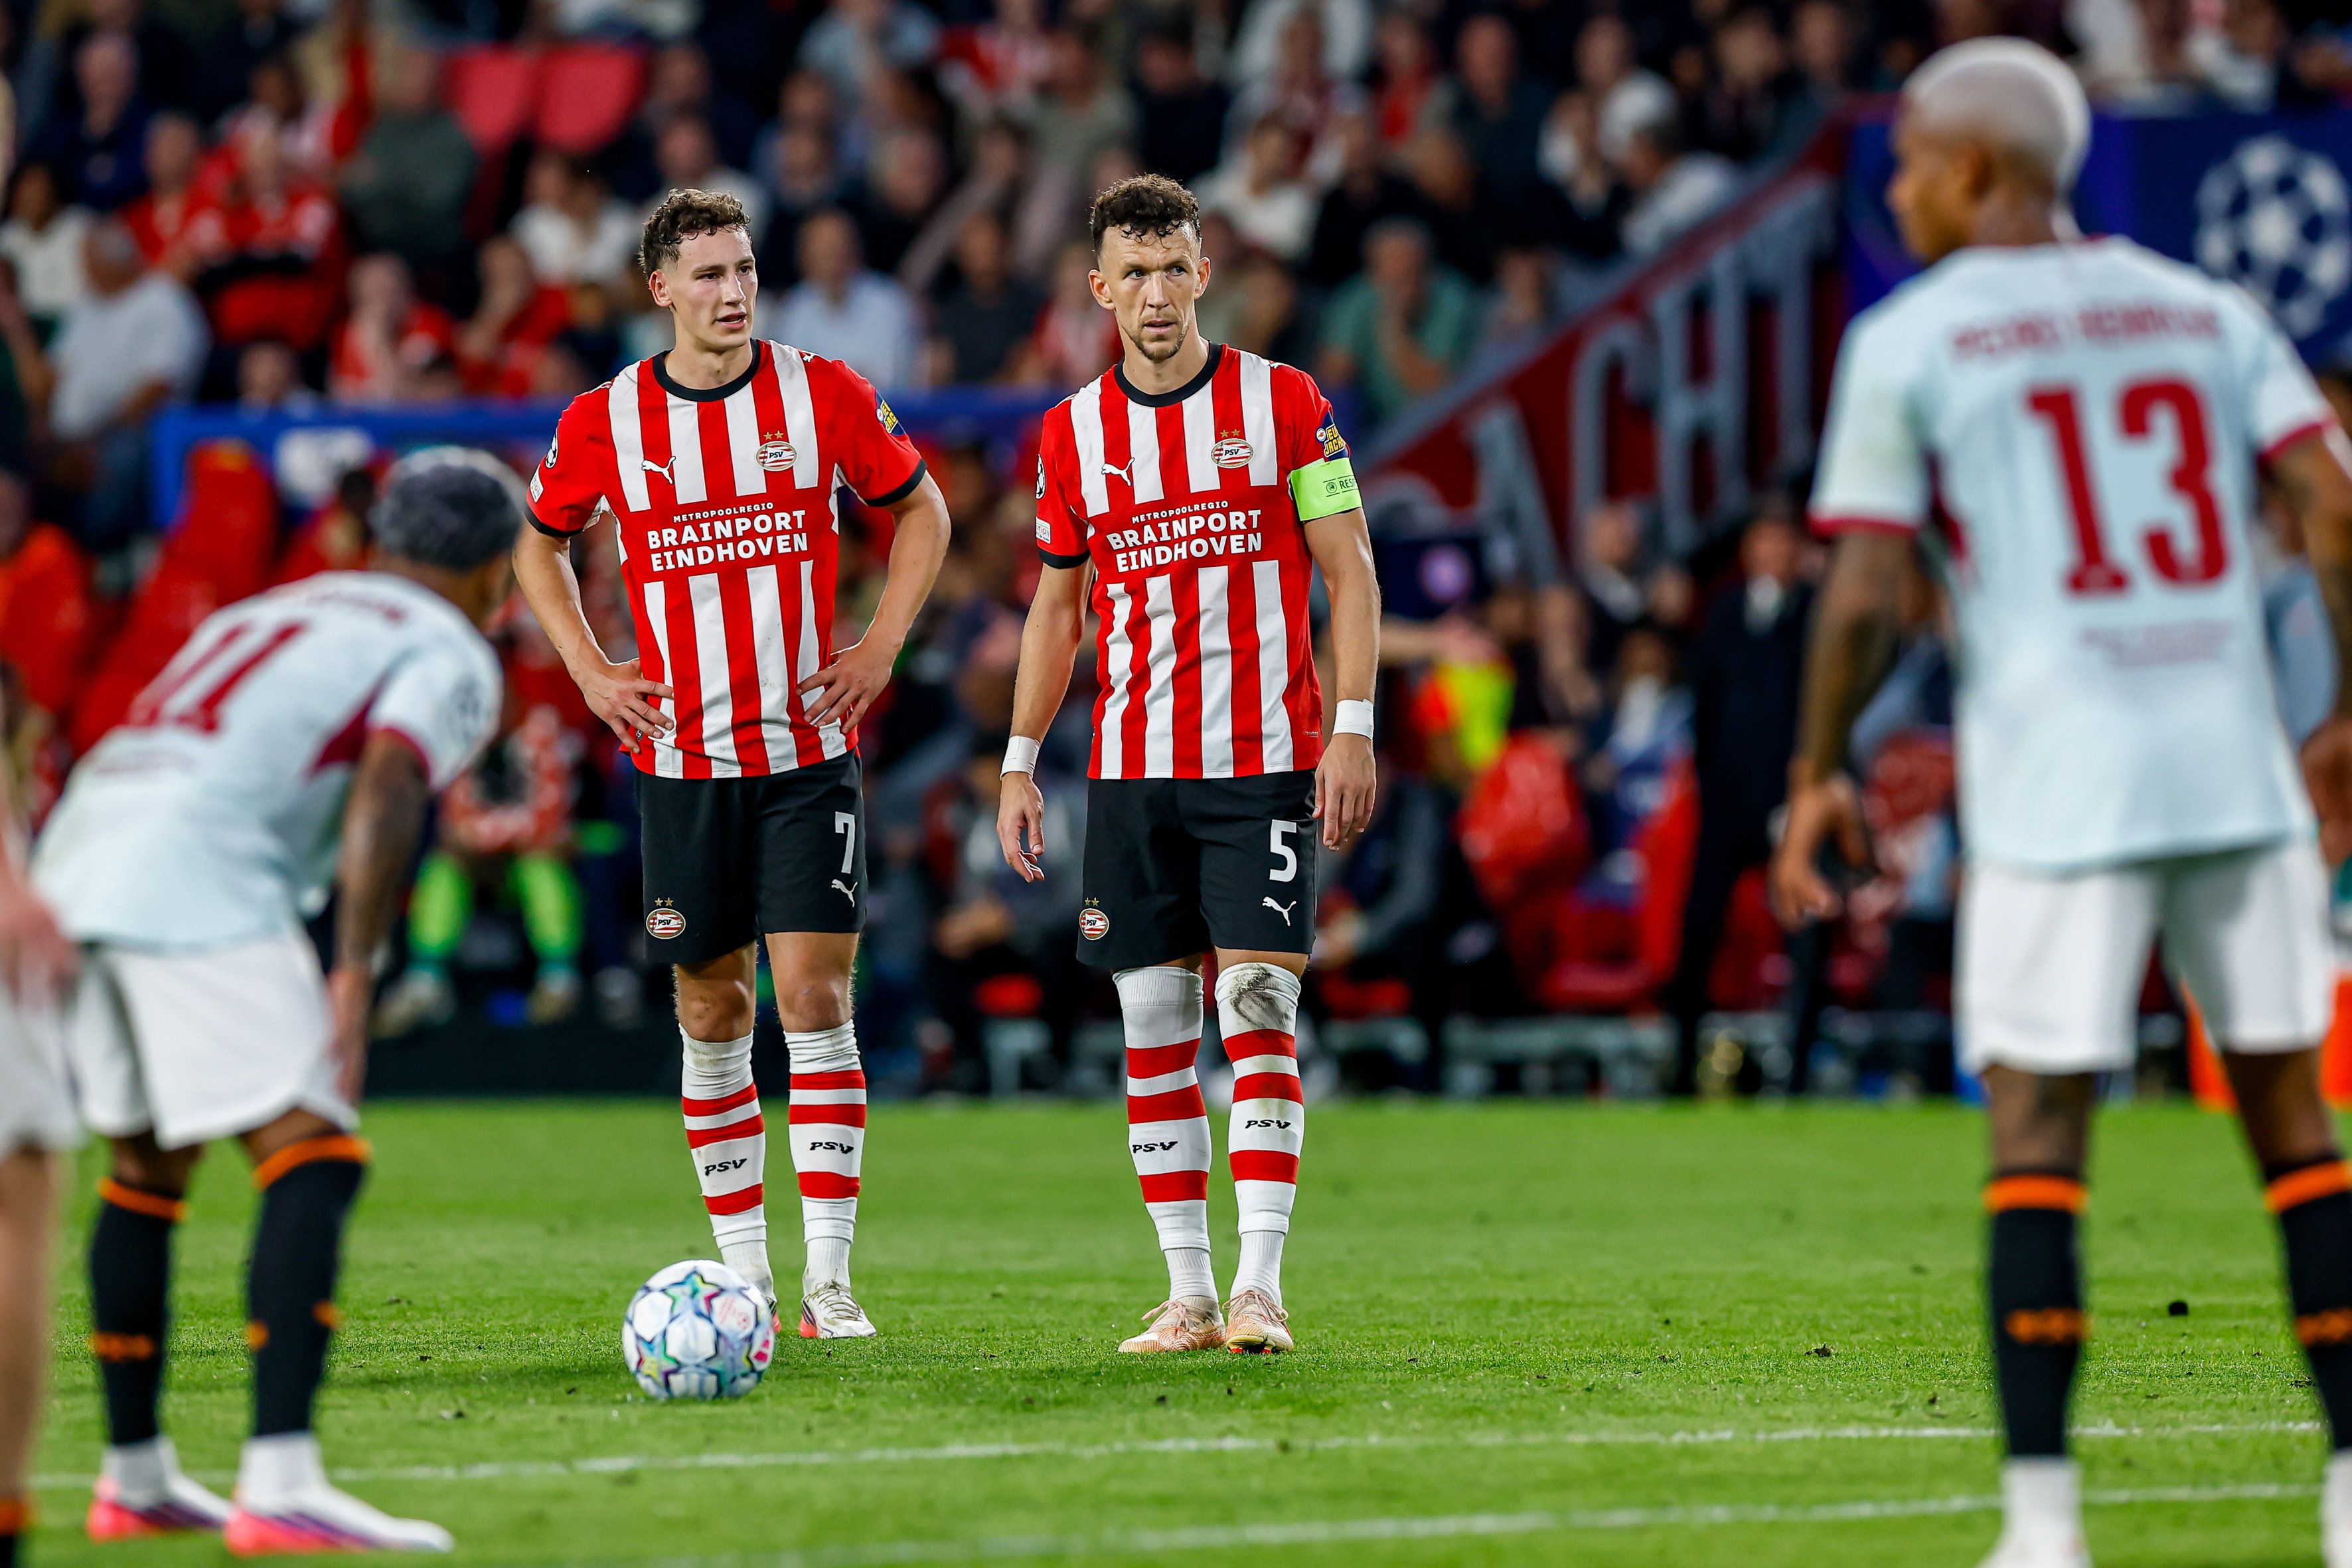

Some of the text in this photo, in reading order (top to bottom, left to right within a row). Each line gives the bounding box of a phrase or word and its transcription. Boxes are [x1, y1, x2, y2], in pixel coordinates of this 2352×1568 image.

[2025, 374, 2229, 597] 13
[647, 509, 806, 550] BRAINPORT
[673, 502, 774, 523] METROPOOLREGIO
[1106, 509, 1261, 550] BRAINPORT
[1132, 501, 1229, 524] METROPOOLREGIO
[651, 532, 808, 572] EINDHOVEN
[1116, 532, 1261, 573] EINDHOVEN
[834, 811, 856, 874] 7
[1269, 819, 1297, 883] 5
[1245, 1119, 1291, 1130] PSV
[704, 1158, 747, 1176] PSV
[809, 1141, 854, 1154] PSV
[1133, 1141, 1178, 1154] PSV
